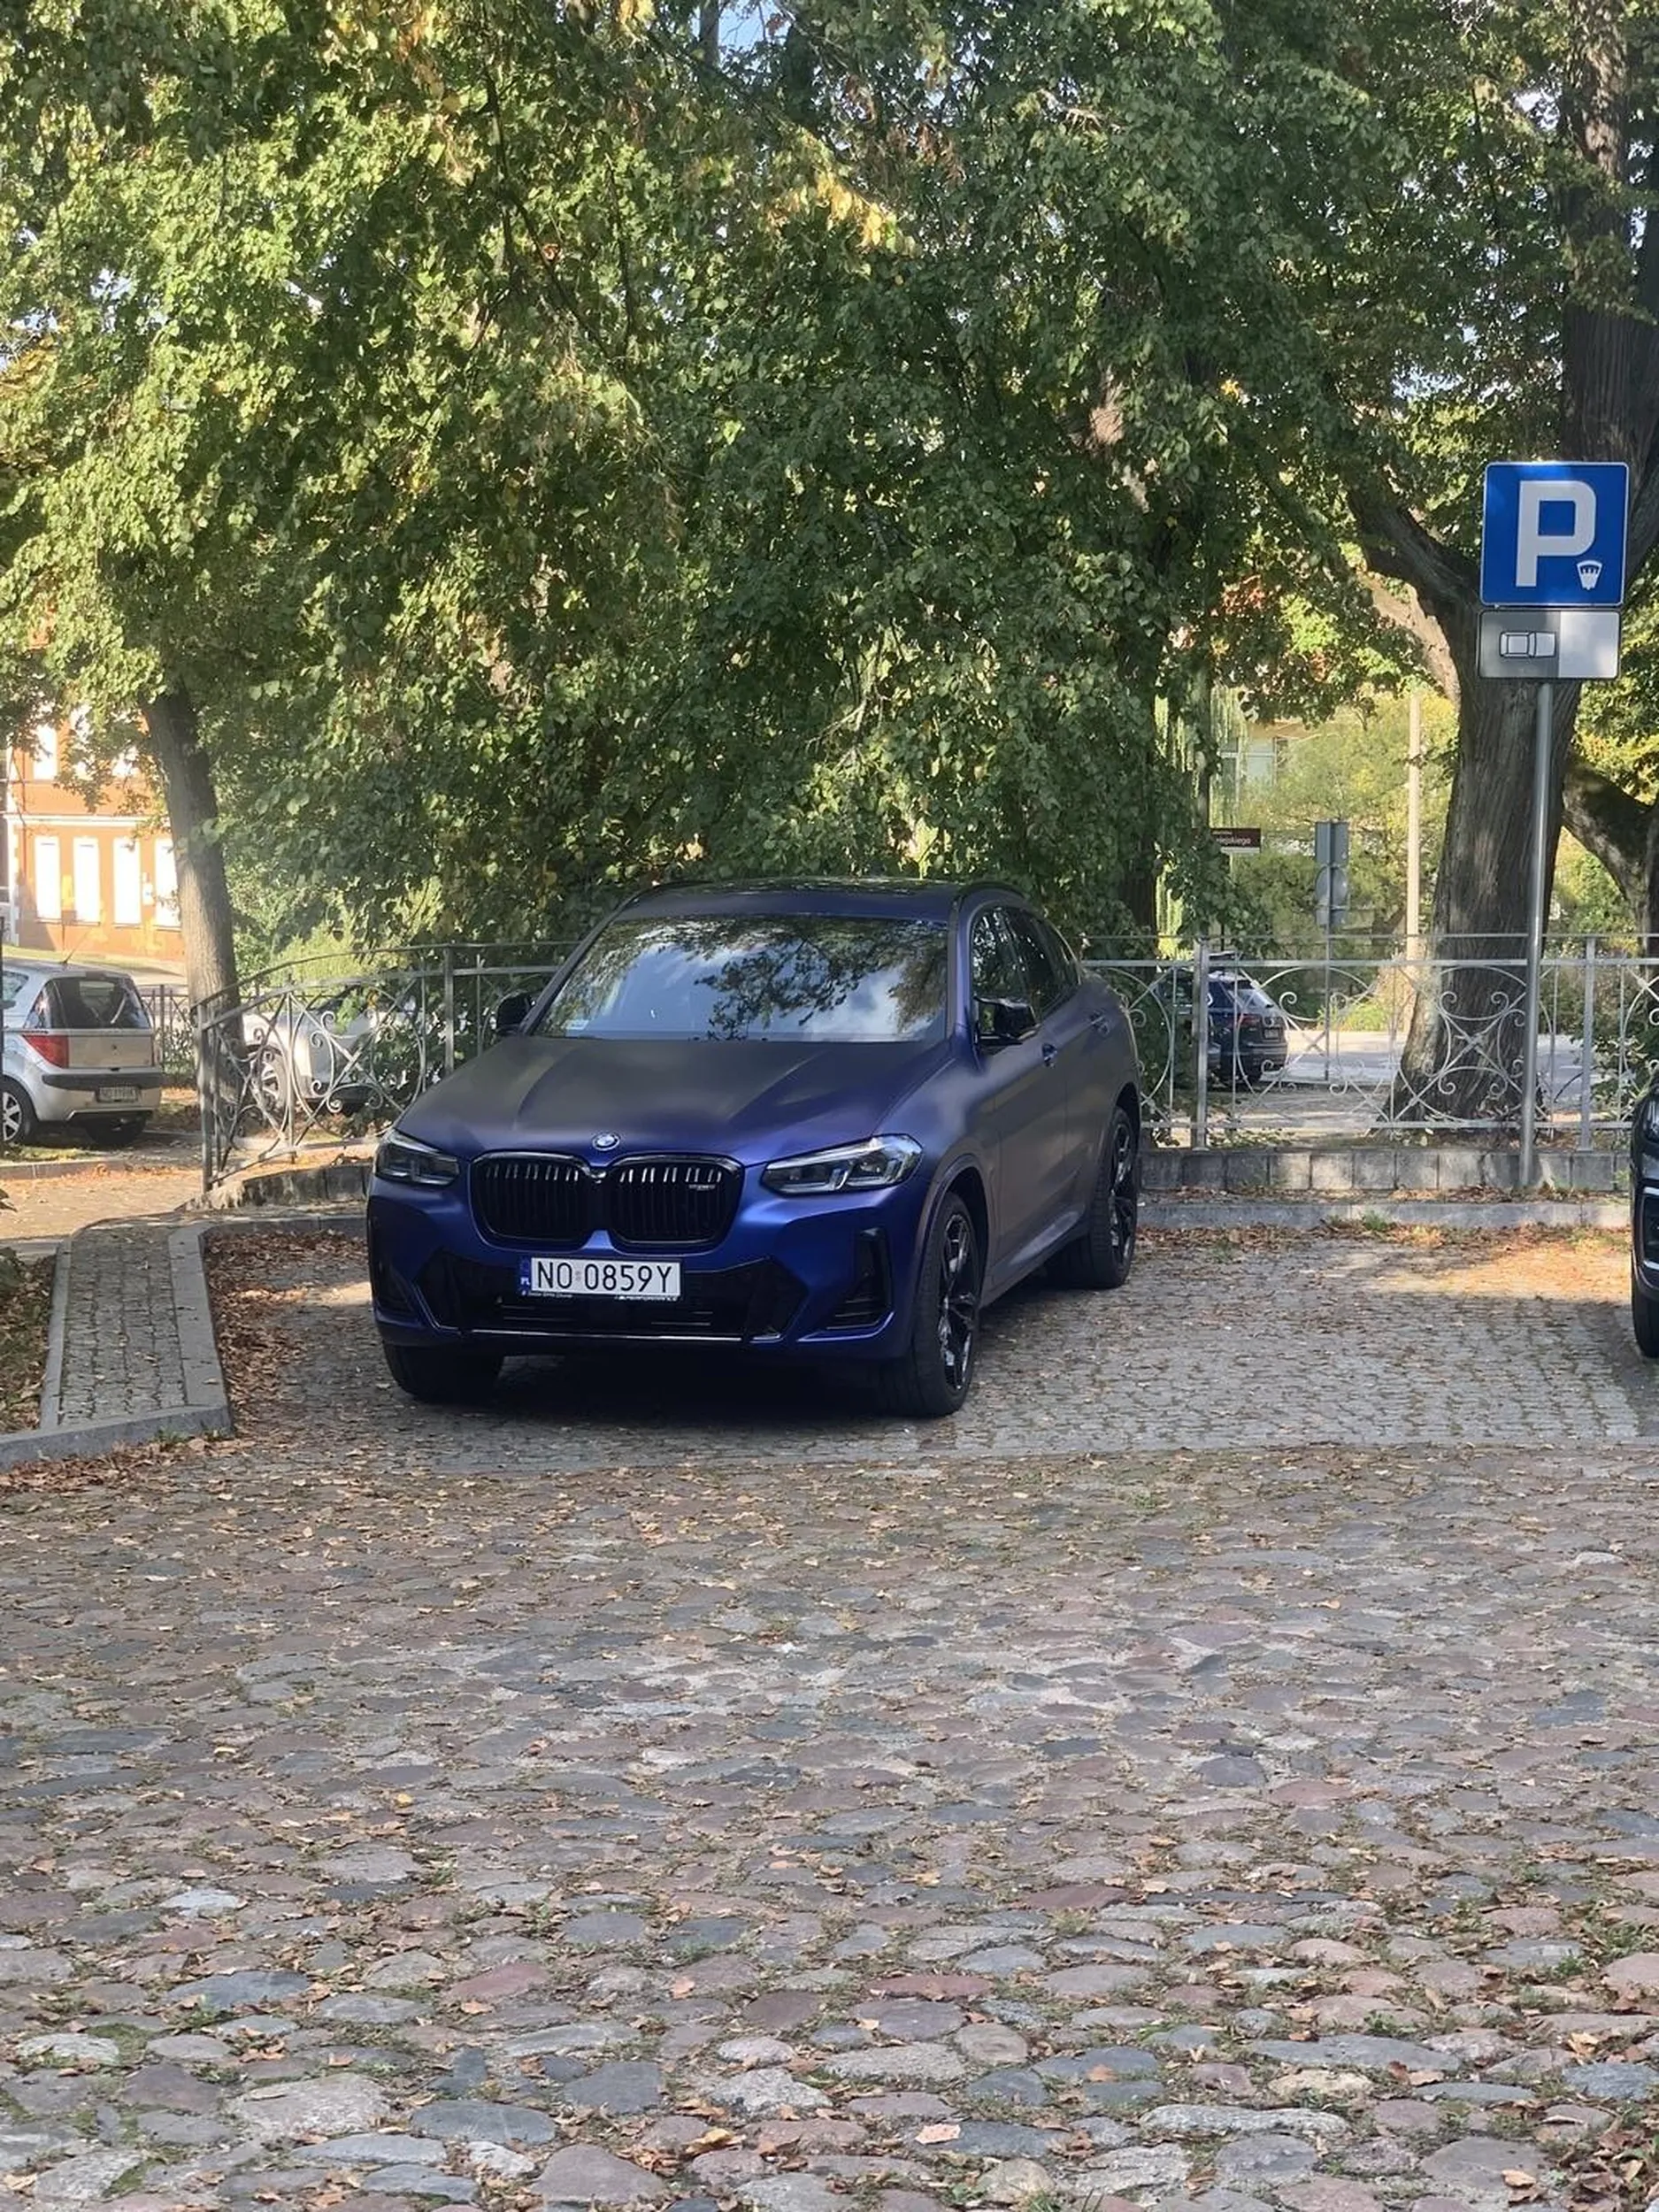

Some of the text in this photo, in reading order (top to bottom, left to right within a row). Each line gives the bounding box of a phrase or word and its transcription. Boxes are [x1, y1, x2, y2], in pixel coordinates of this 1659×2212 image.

[1516, 480, 1596, 588] P
[537, 1261, 672, 1293] NO 0859Y
